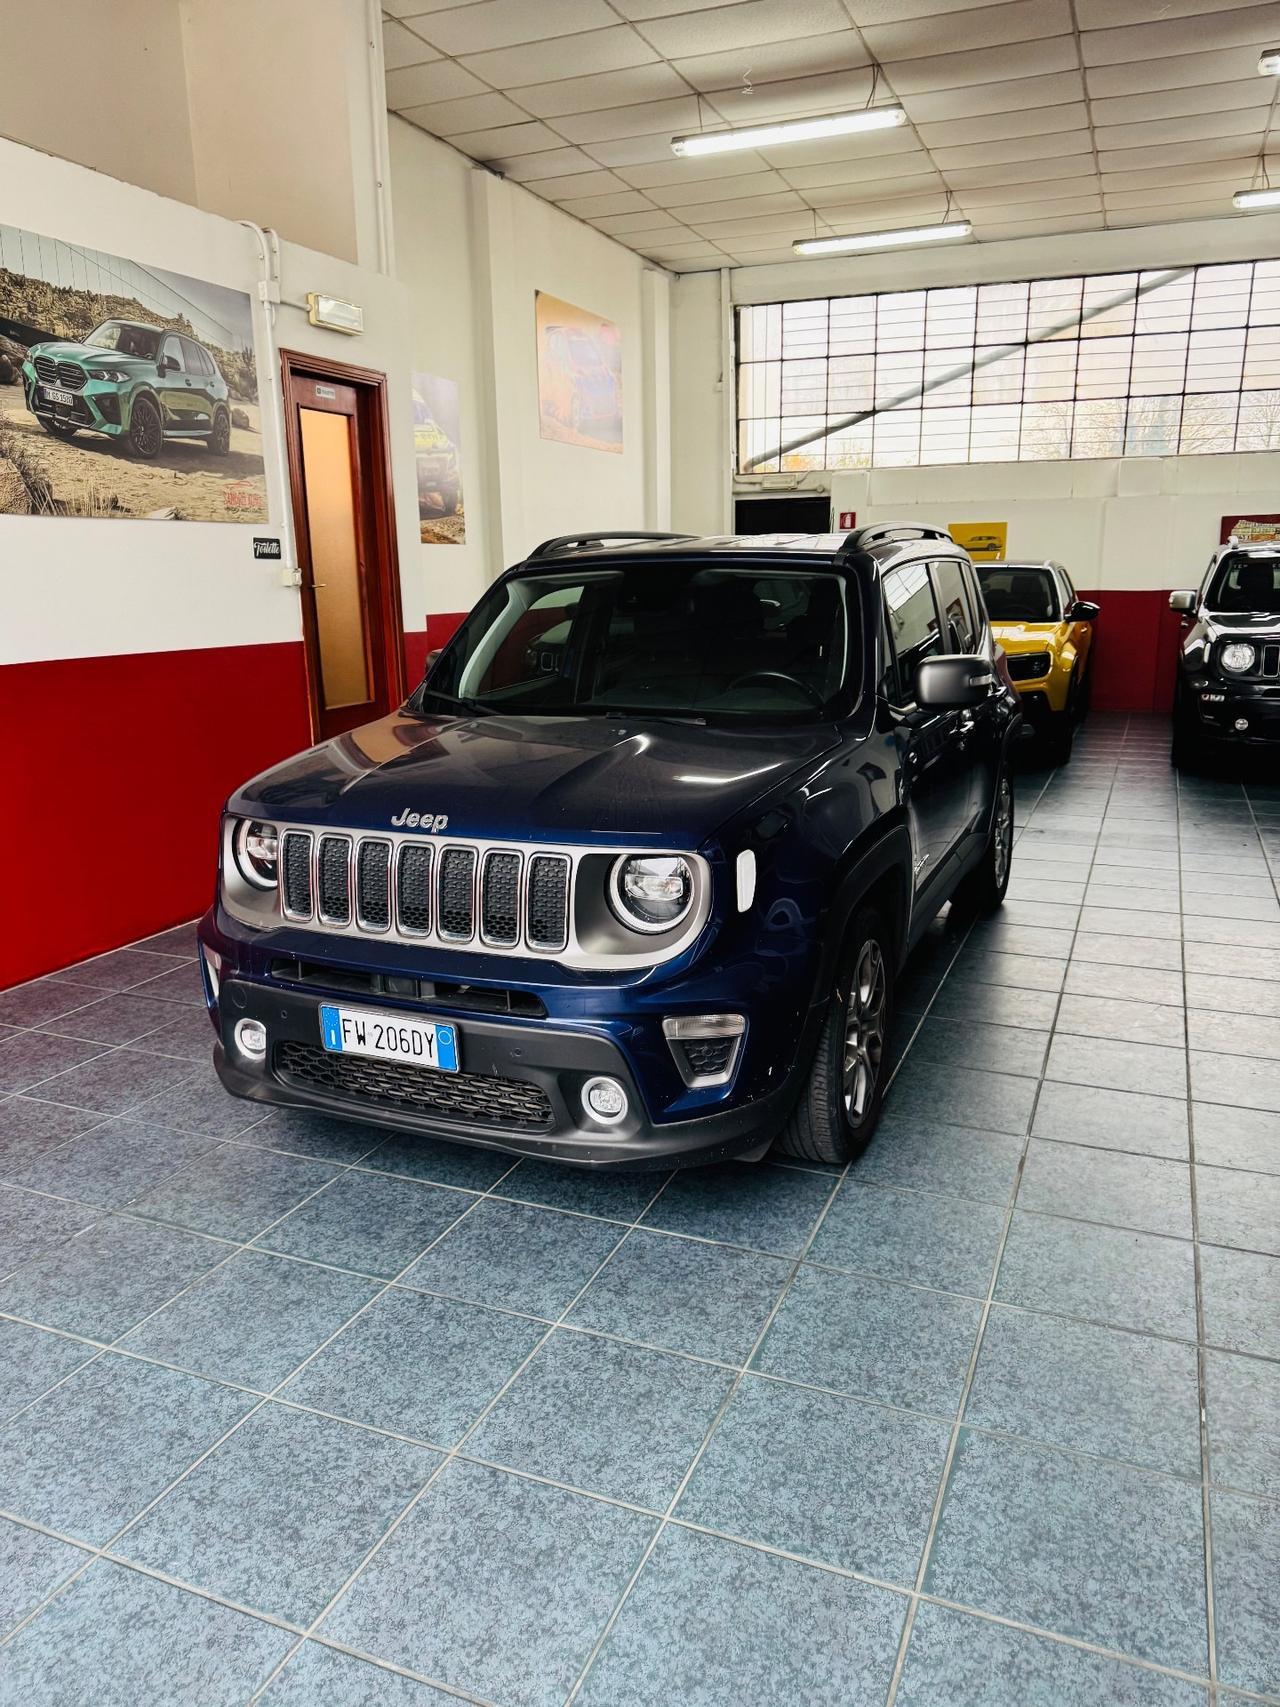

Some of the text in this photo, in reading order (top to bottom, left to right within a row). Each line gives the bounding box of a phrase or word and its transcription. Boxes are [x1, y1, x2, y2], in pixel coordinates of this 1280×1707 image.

[253, 541, 280, 557] Toilette
[391, 807, 449, 834] Jeep
[341, 1018, 366, 1046] FW
[373, 1023, 435, 1059] 206DY
